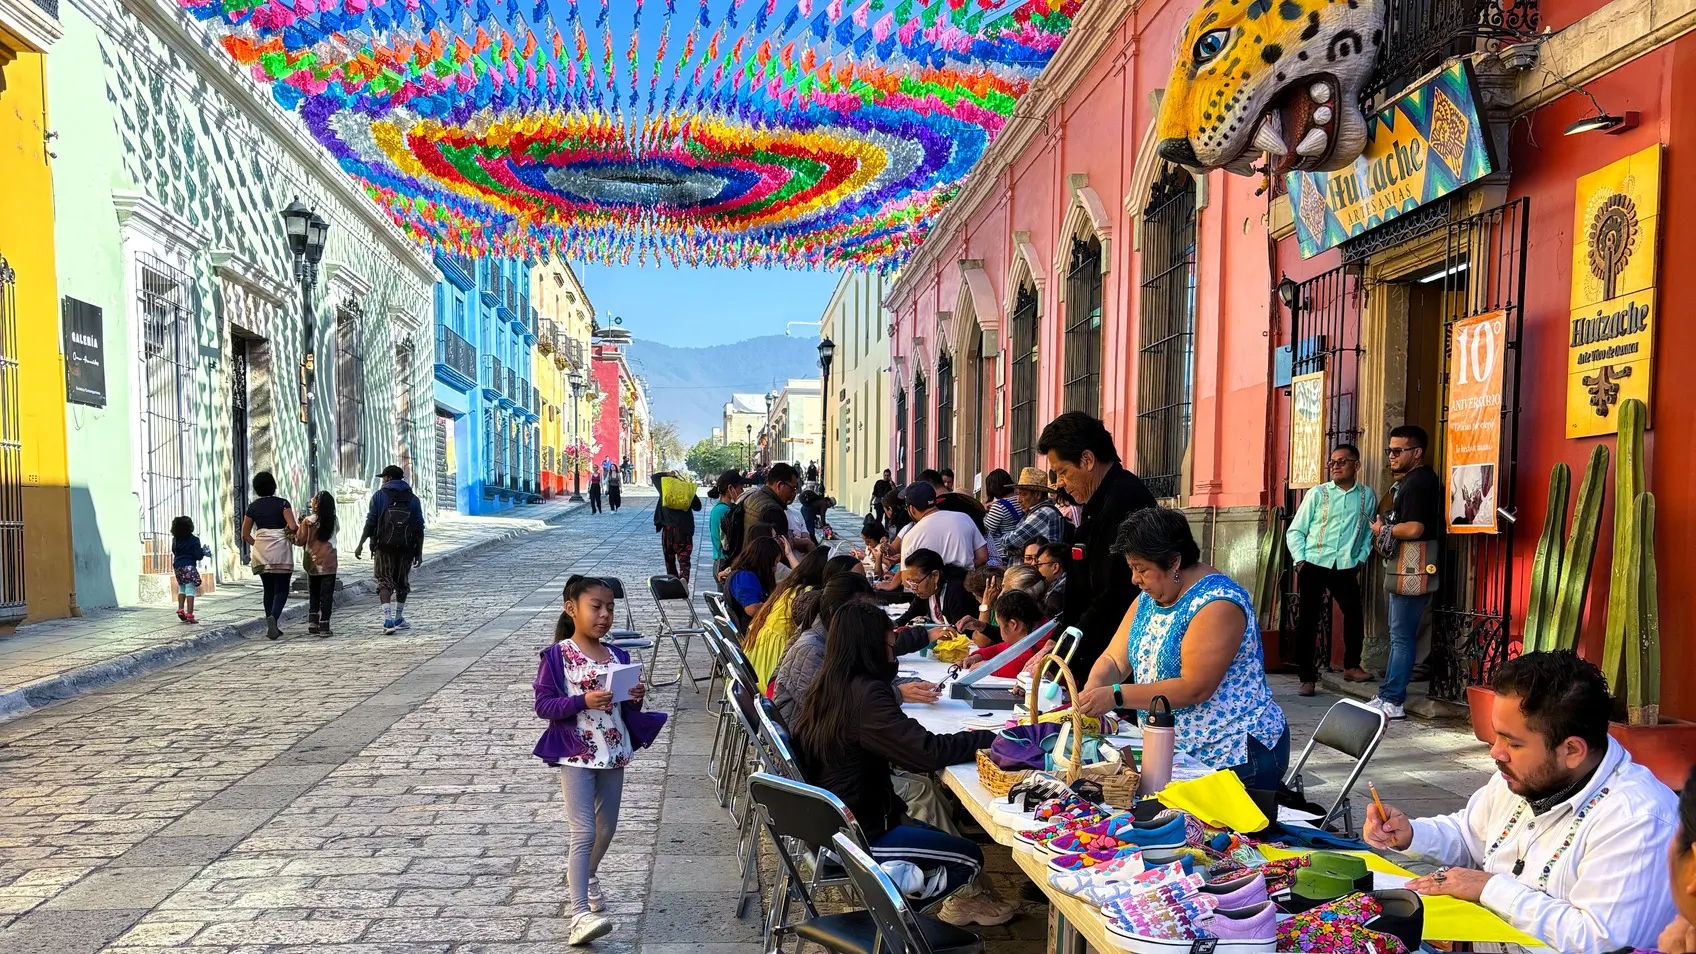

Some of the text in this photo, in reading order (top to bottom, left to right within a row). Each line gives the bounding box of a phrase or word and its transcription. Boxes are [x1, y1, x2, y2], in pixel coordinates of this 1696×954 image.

[1327, 137, 1423, 212] Huizache
[1347, 183, 1412, 226] ARTESANIAS
[71, 331, 98, 349] GALERÍA
[1570, 301, 1649, 348] Huizache
[1606, 346, 1614, 359] de
